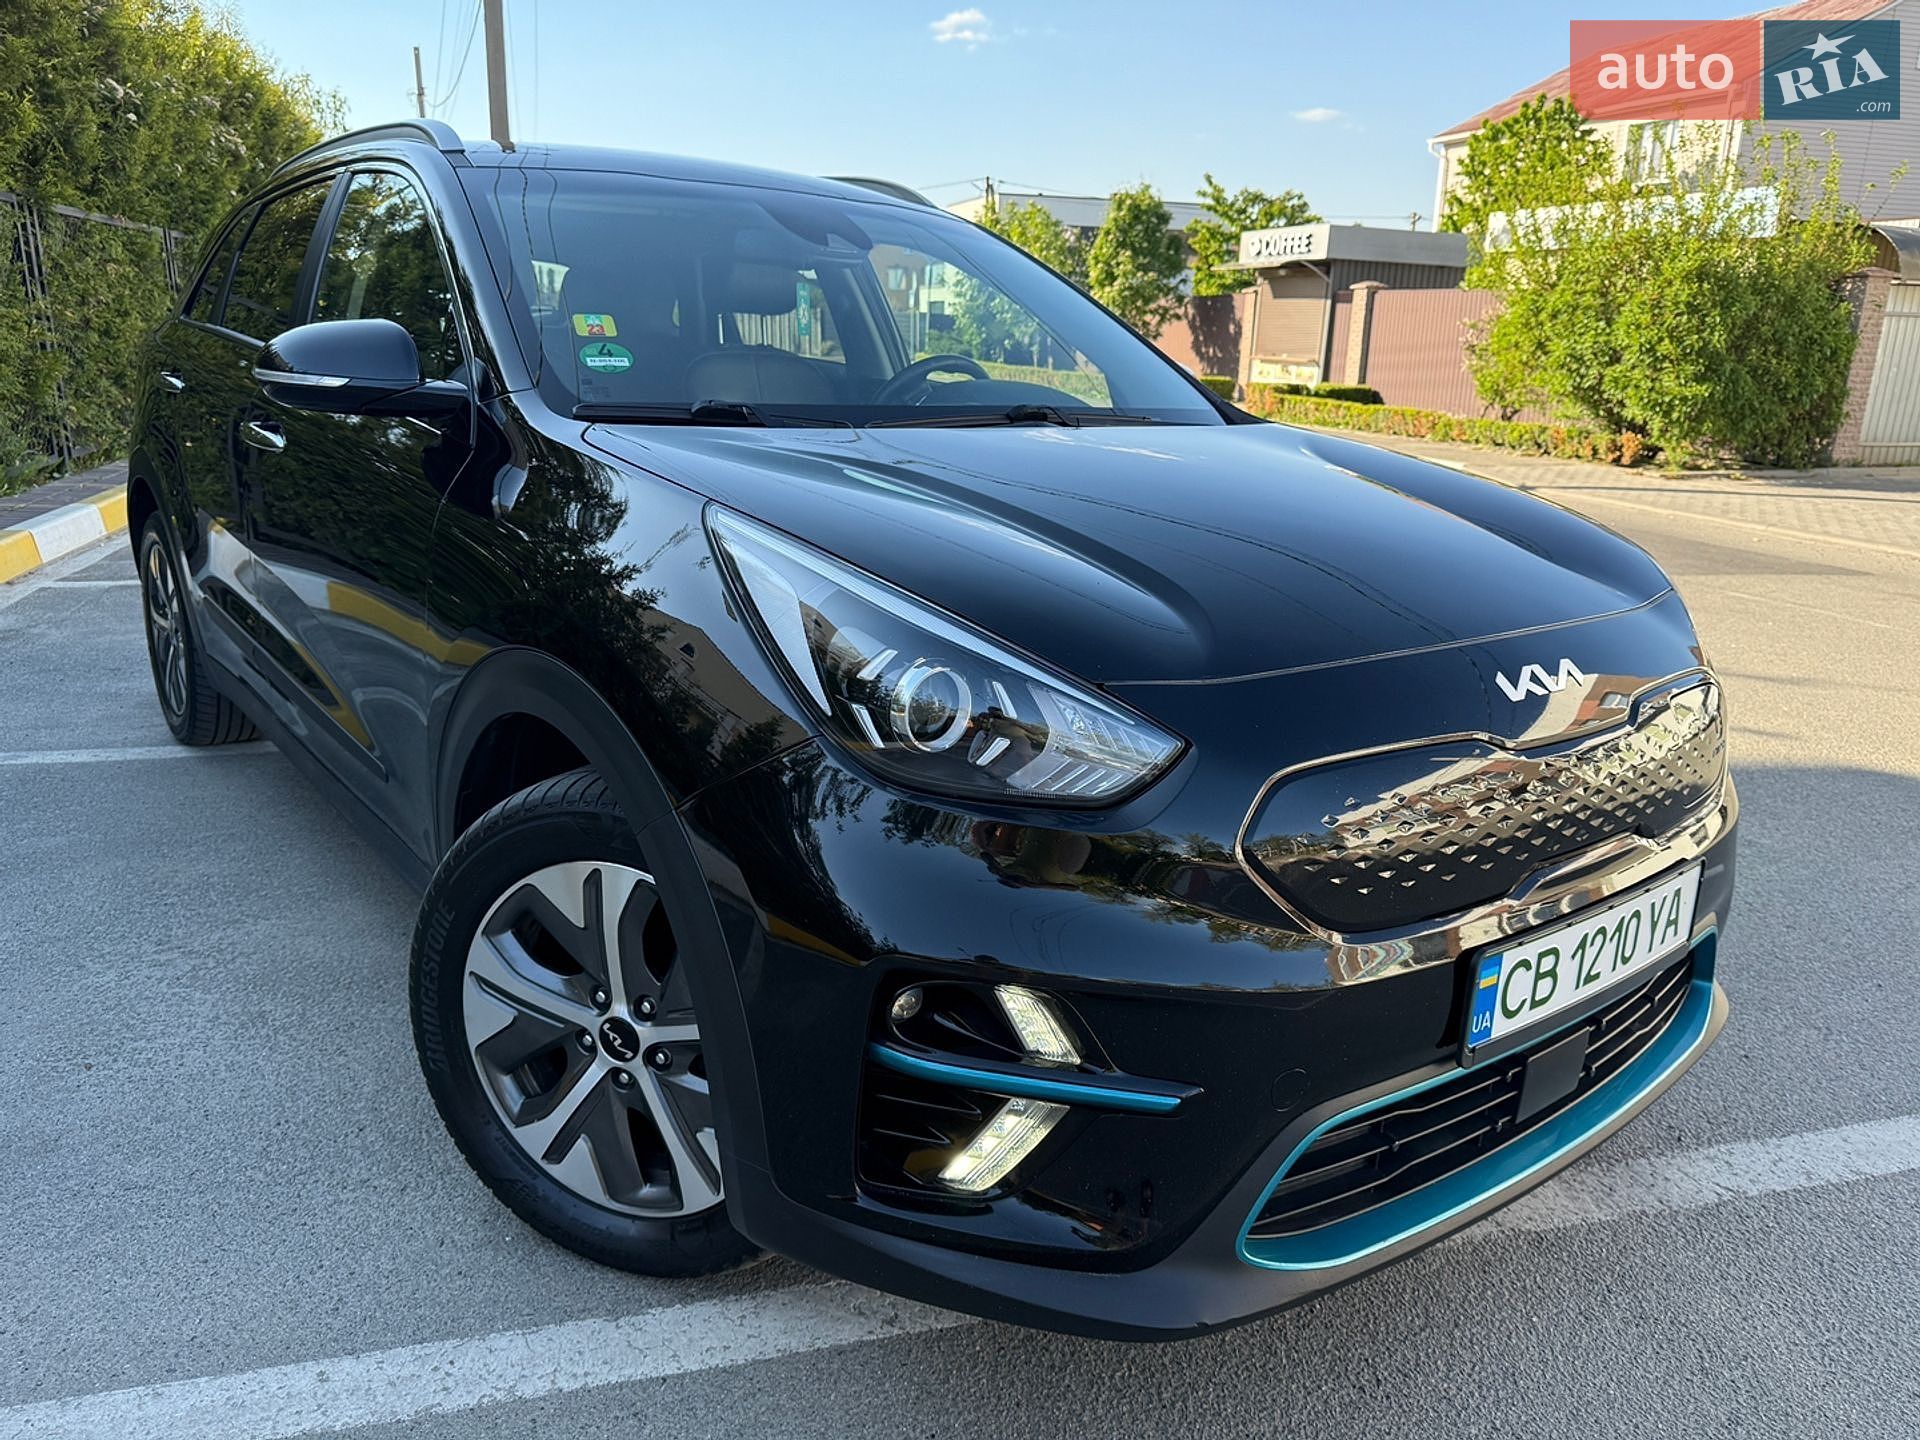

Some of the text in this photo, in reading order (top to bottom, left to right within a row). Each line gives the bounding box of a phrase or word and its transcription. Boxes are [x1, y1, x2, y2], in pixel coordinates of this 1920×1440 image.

[1263, 232, 1312, 256] COFFEE
[598, 343, 613, 357] 4
[1495, 658, 1584, 702] KIA
[1501, 887, 1682, 1019] CB 1210 YA
[422, 902, 455, 1071] BRIDGESTONE
[1472, 1010, 1491, 1033] UA
